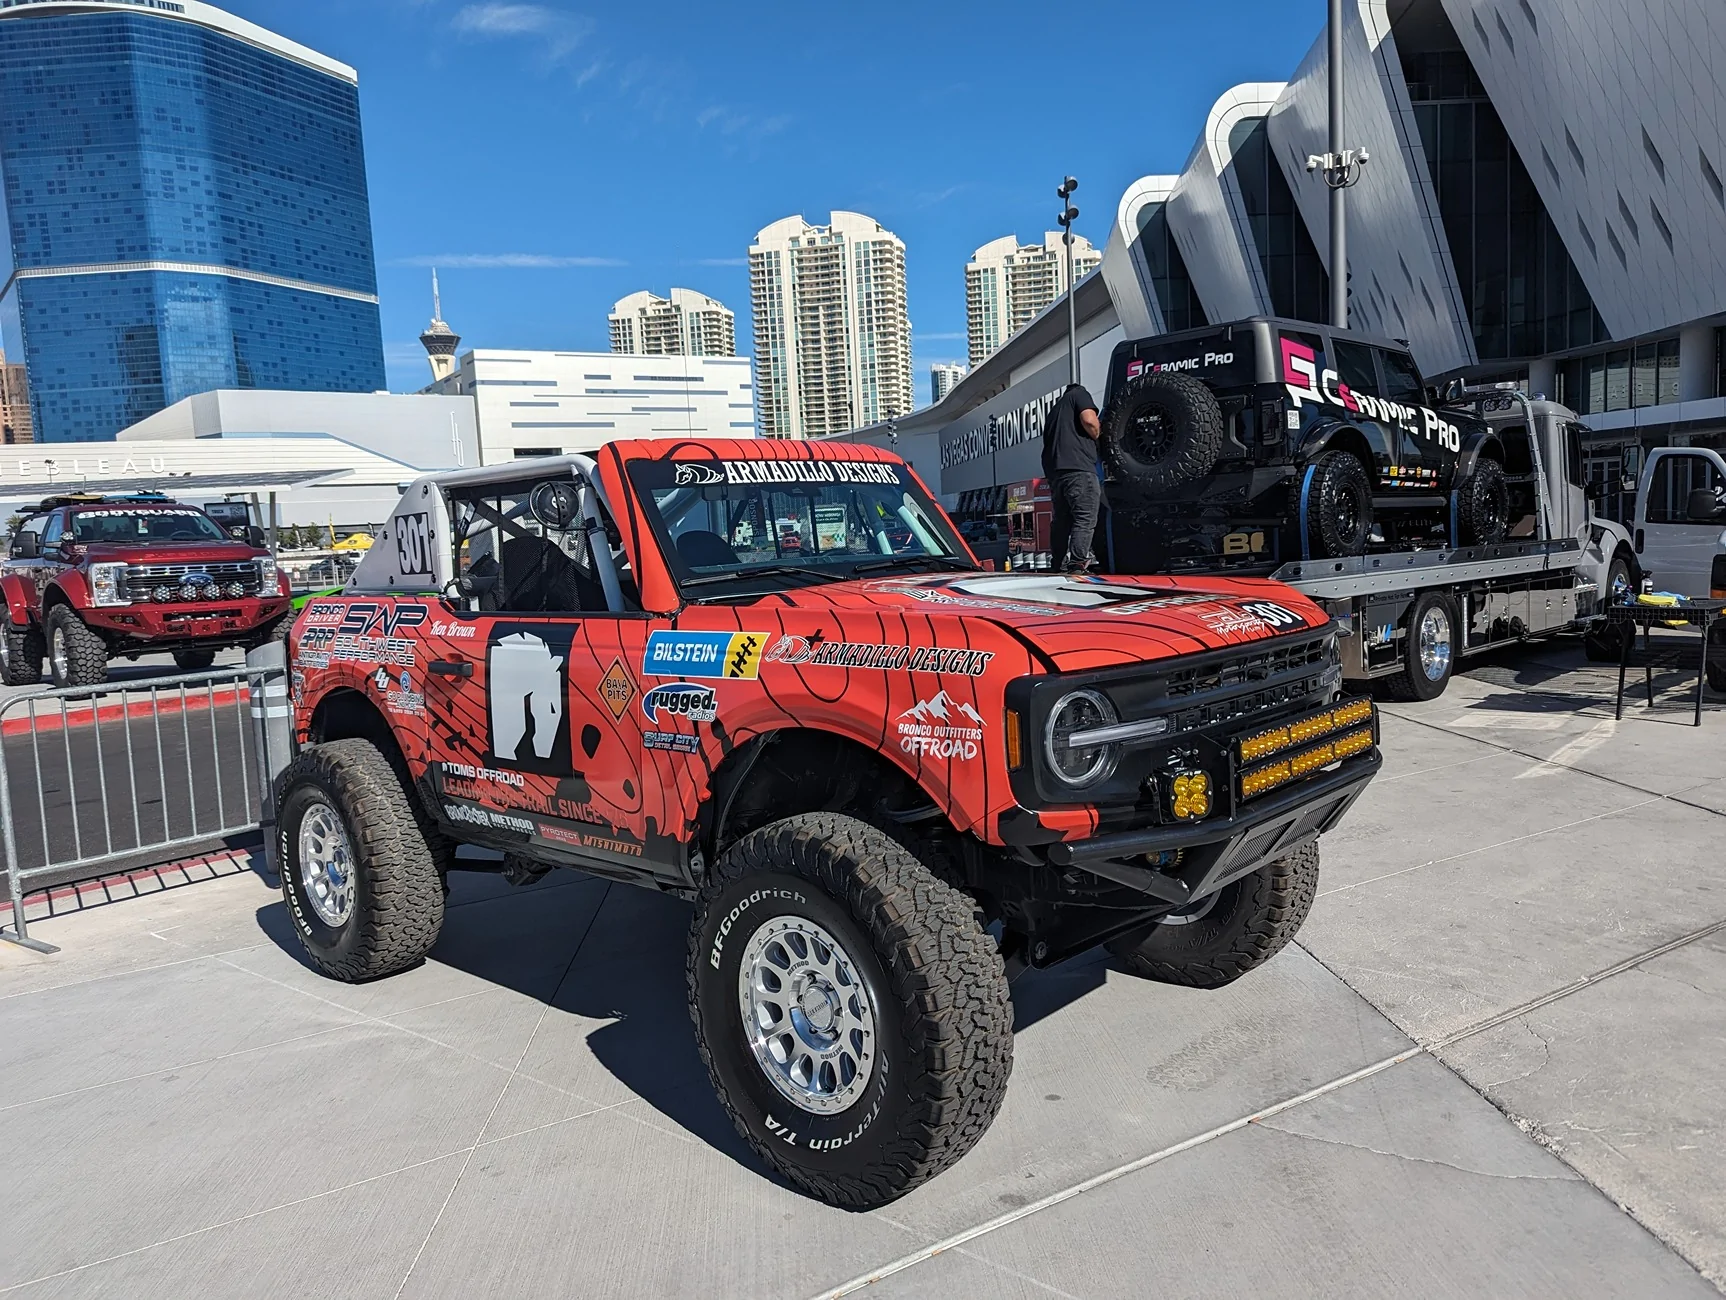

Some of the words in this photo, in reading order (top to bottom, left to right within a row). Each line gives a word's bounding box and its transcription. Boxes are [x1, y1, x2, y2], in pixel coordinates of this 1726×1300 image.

[968, 407, 1022, 460] CONVETION
[722, 460, 835, 485] ARMADILLO
[834, 461, 901, 485] DESIGNS
[77, 509, 202, 519] BODYGUARD
[396, 513, 433, 574] 301
[1241, 602, 1303, 627] 301
[430, 620, 448, 636] Ken
[446, 620, 477, 638] Brown
[653, 642, 719, 663] BILSTEIN
[810, 641, 911, 670] ARMADILLO
[906, 646, 995, 677] DESIGNS
[607, 689, 628, 701] PITS
[686, 710, 716, 721] radios
[643, 731, 675, 748] SURF
[675, 734, 700, 753] CITY
[898, 723, 932, 736] BRONCO
[933, 725, 983, 741] OUTFITTERS
[900, 735, 978, 762] OFFROAD
[447, 762, 476, 778] TOMS
[476, 766, 525, 787] OFFROAD
[489, 812, 535, 831] METHOD
[557, 798, 604, 825] SINCE
[540, 826, 578, 840] PYROTECT
[281, 830, 313, 936] BFGoodrich
[710, 887, 808, 970] BFGoodrich
[764, 1114, 798, 1146] T/A
